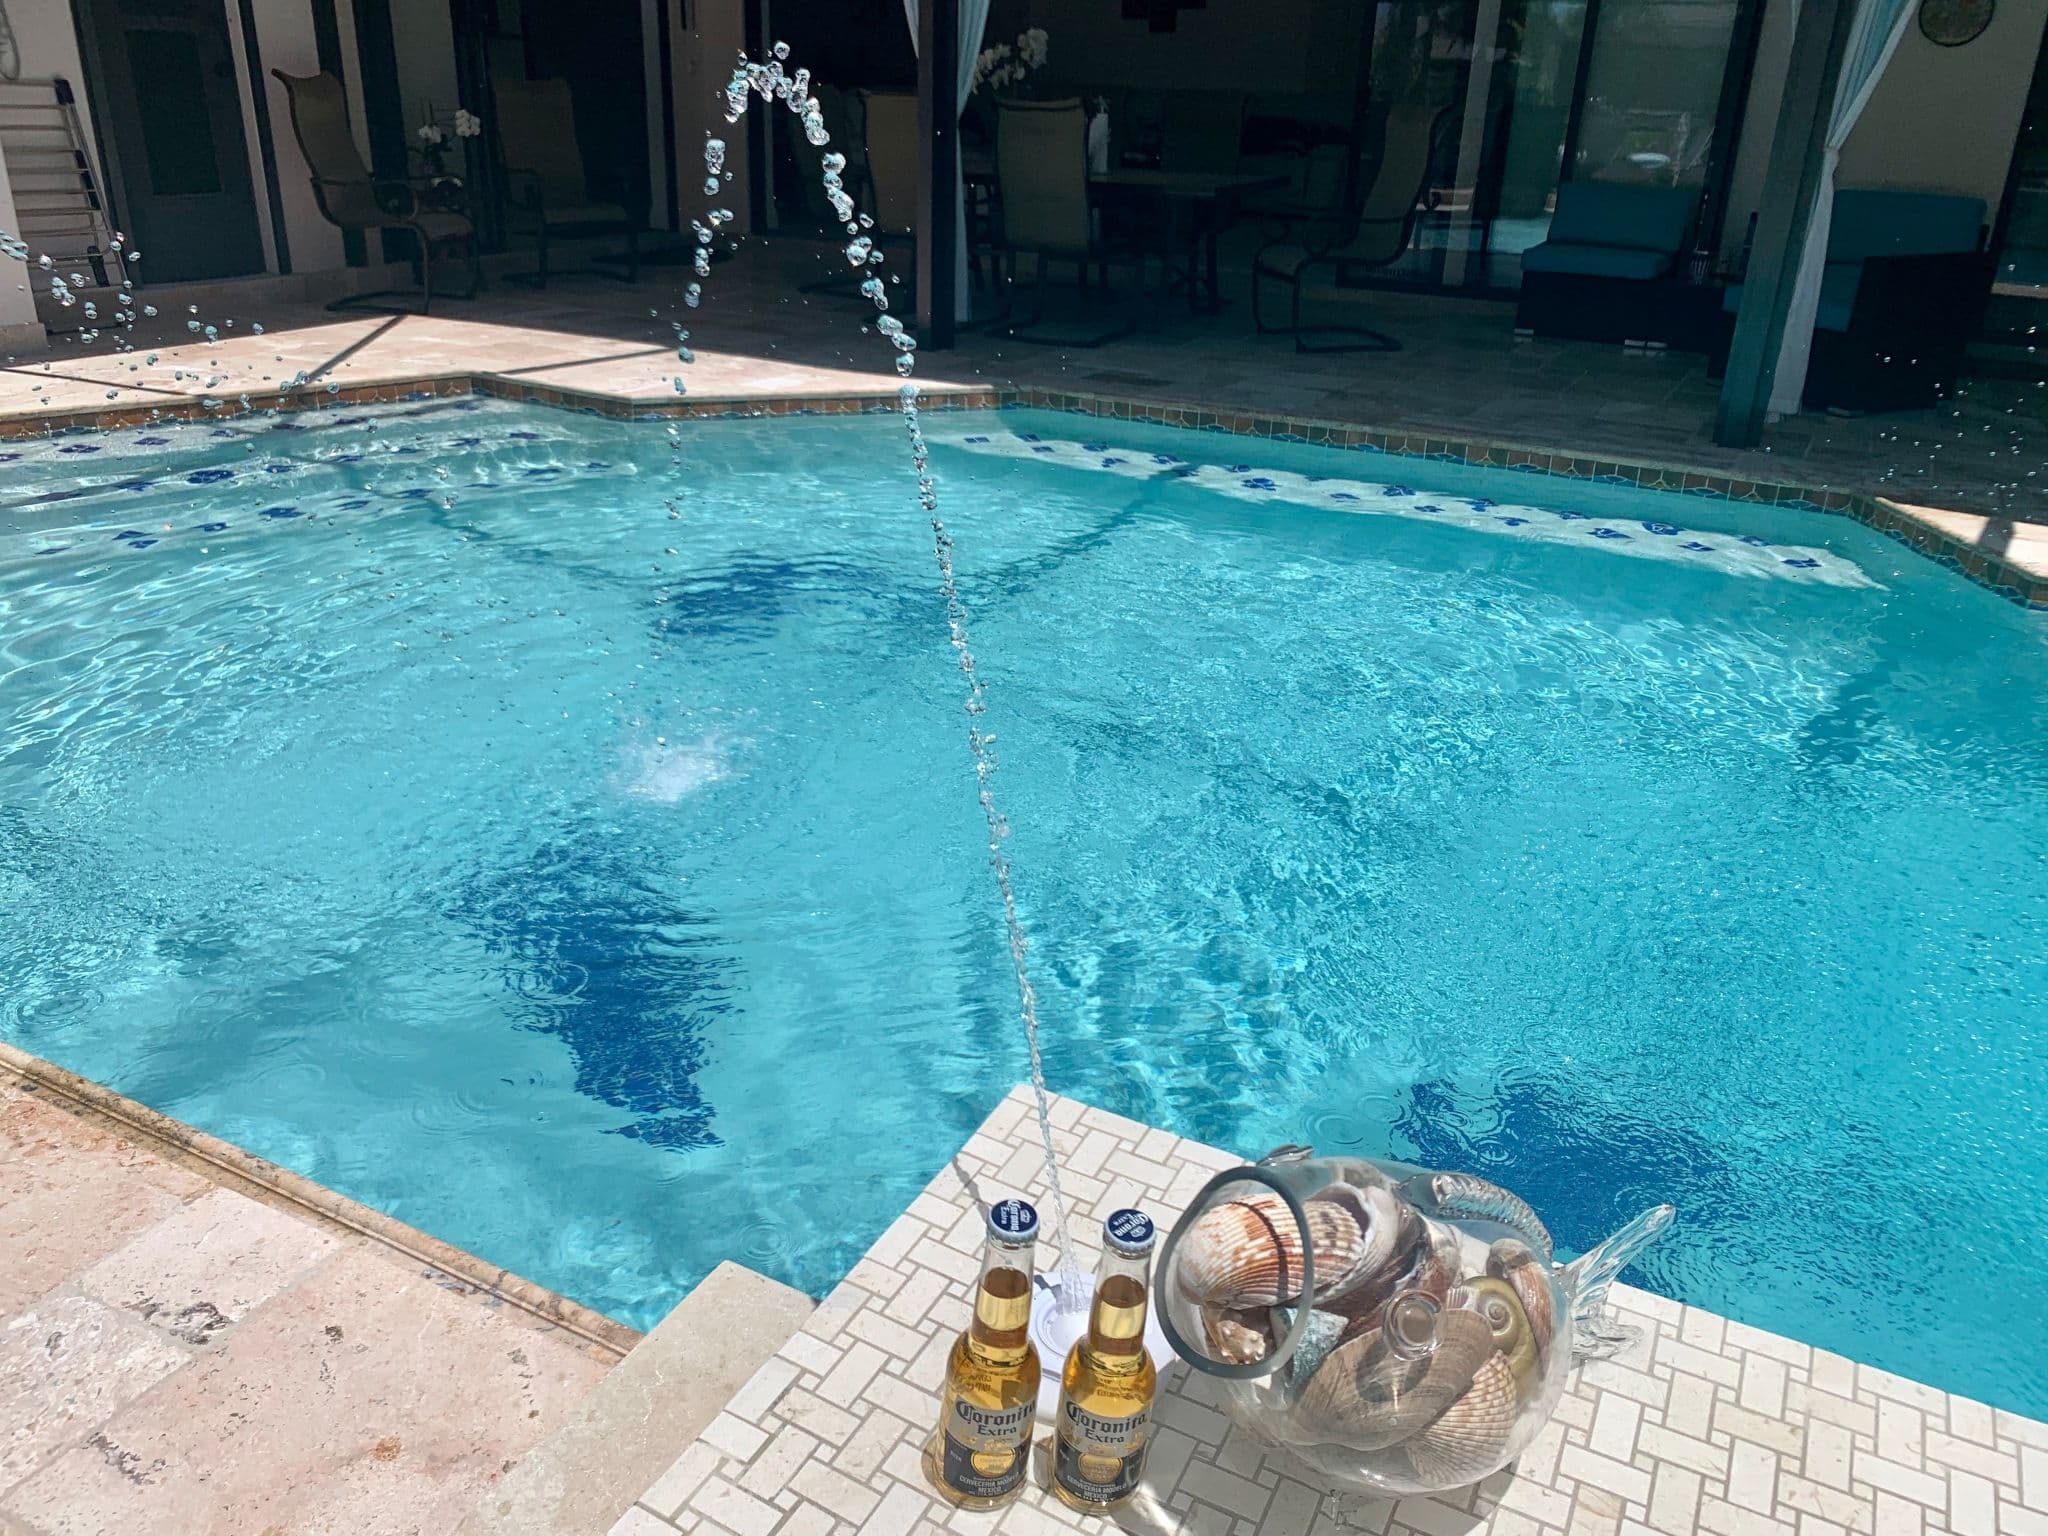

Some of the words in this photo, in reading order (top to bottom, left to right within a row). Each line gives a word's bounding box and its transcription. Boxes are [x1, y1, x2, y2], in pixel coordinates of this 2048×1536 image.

[1007, 1200, 1021, 1232] Corona
[1114, 1212, 1149, 1237] Corona
[1066, 1401, 1146, 1434] Coronita
[977, 1425, 1017, 1436] Extra
[1085, 1430, 1124, 1443] Extra
[959, 1475, 996, 1488] CERVECERIA
